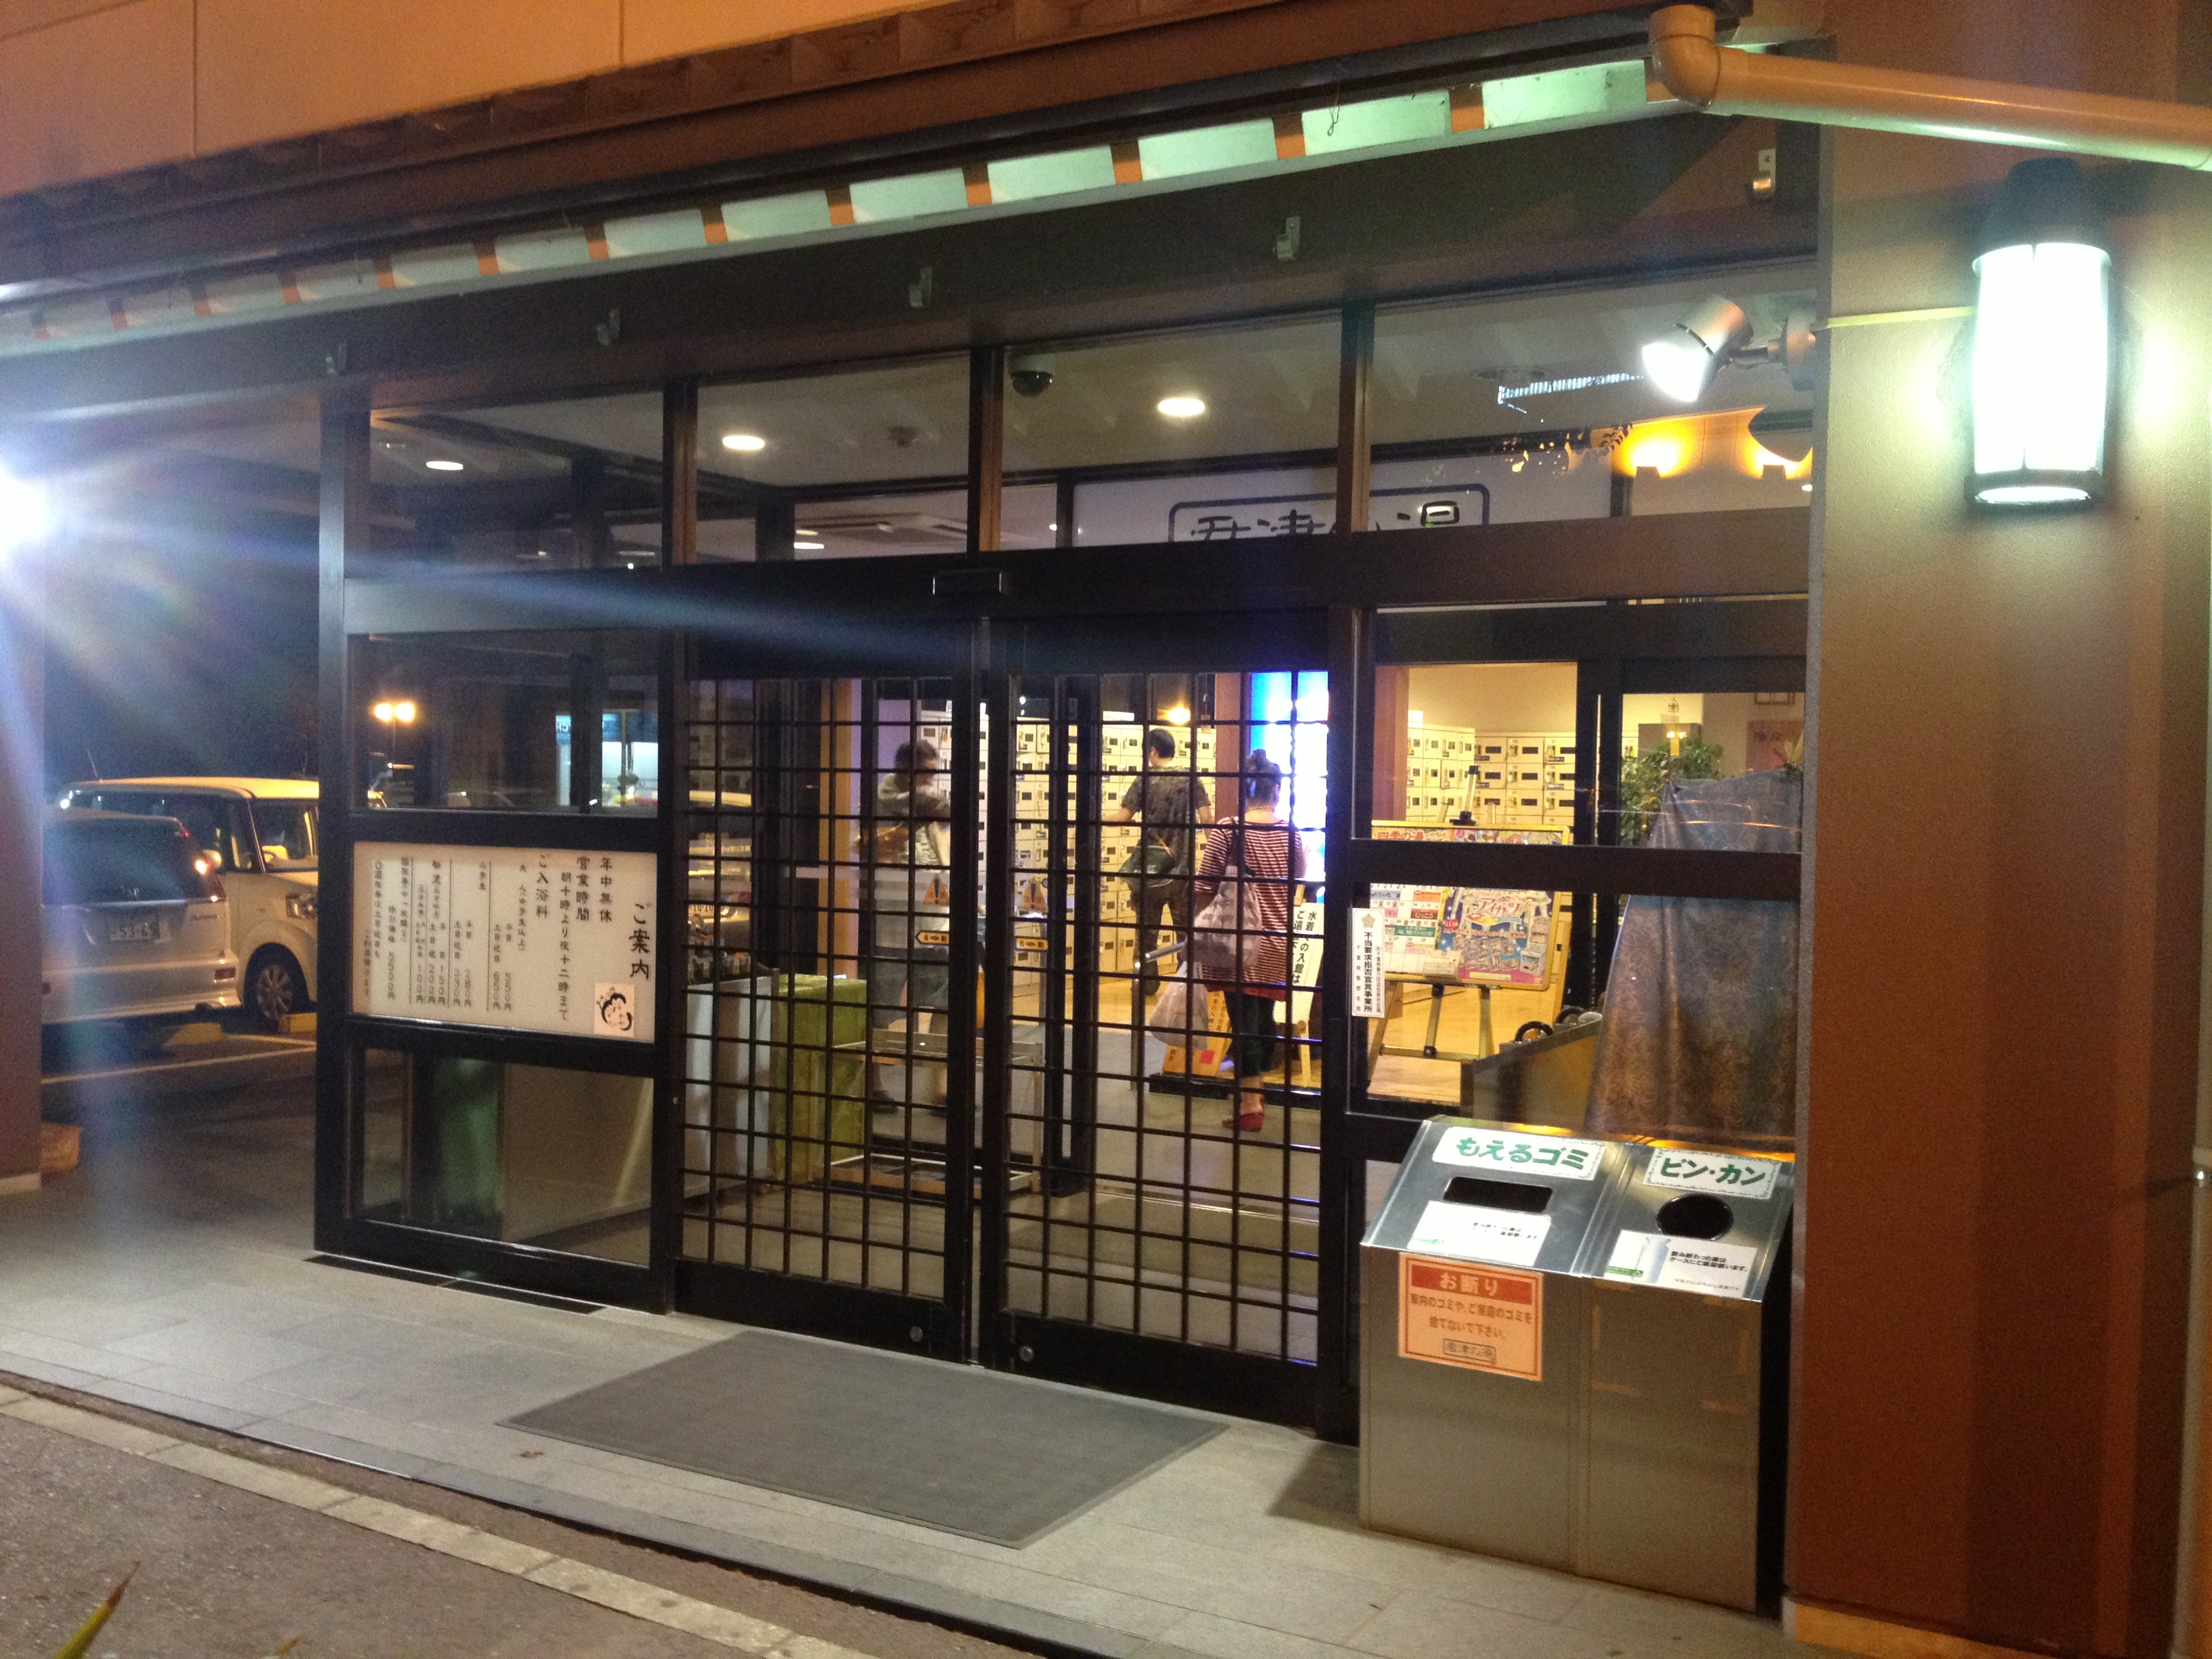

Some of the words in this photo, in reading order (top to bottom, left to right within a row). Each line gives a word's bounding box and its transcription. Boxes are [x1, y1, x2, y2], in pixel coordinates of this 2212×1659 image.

[536, 853, 550, 918] ご入浴料
[576, 855, 590, 922] 営業時間
[599, 857, 612, 922] 年中無休
[629, 902, 651, 980] ご案内
[1293, 911, 1317, 984] 水着の入館は
[1364, 932, 1373, 1012] 不当要求拒否宣言事業所
[1456, 1137, 1589, 1170] もえるゴミ
[1660, 1158, 1766, 1186] ビン・カン
[1439, 1272, 1499, 1296] お断り
